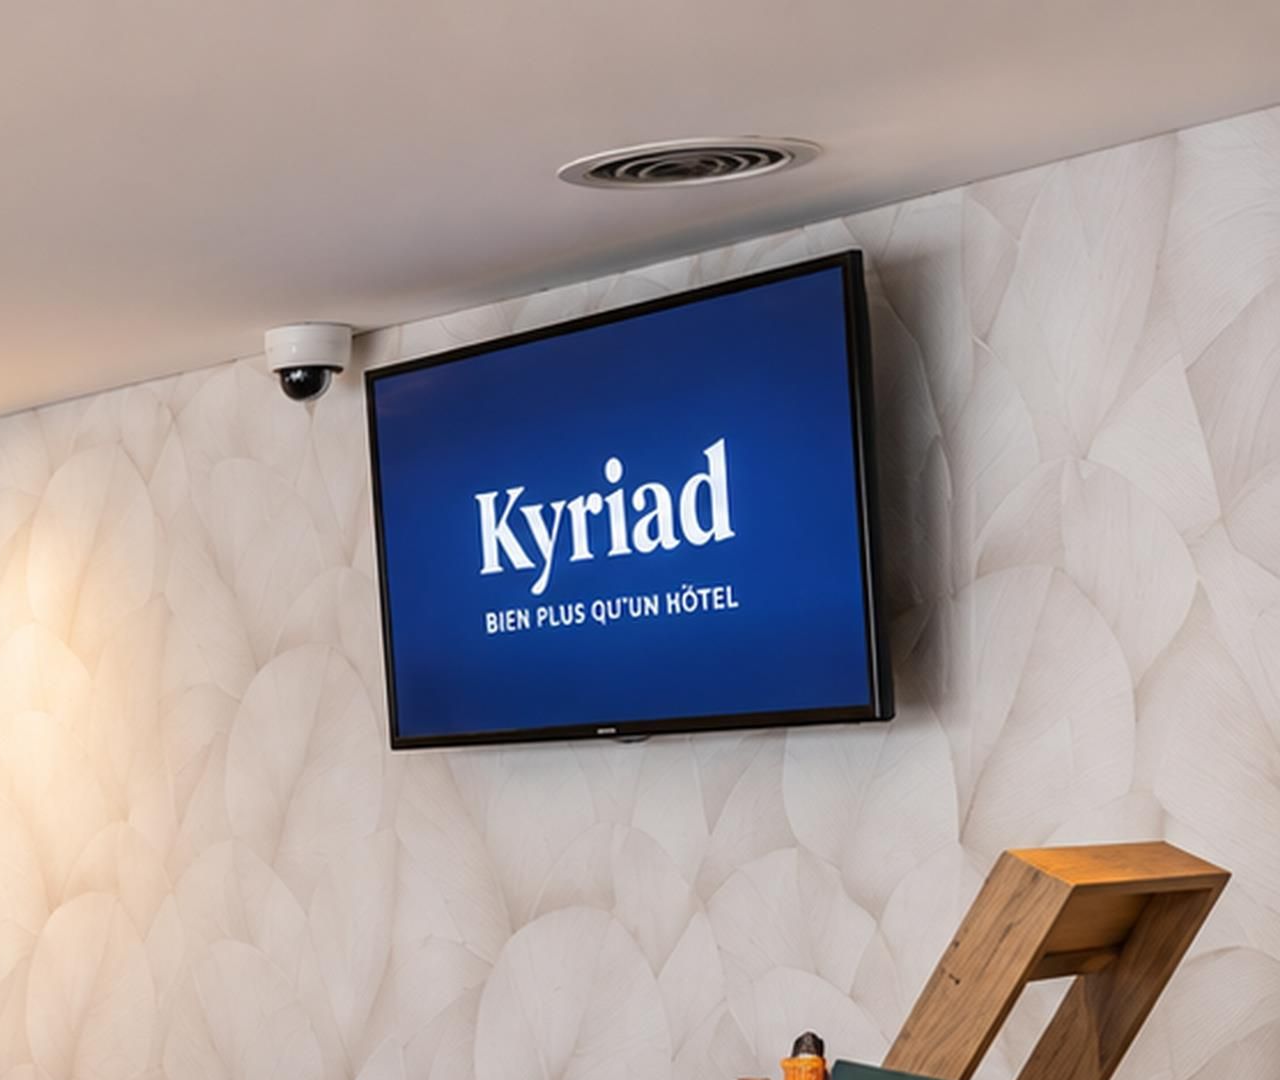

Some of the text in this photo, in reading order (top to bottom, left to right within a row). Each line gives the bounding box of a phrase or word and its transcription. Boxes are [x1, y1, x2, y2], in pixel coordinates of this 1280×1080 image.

[474, 437, 736, 595] Kyriad
[485, 609, 531, 634] BIEN
[536, 602, 586, 628] PLUS
[591, 594, 659, 625] QU'UN
